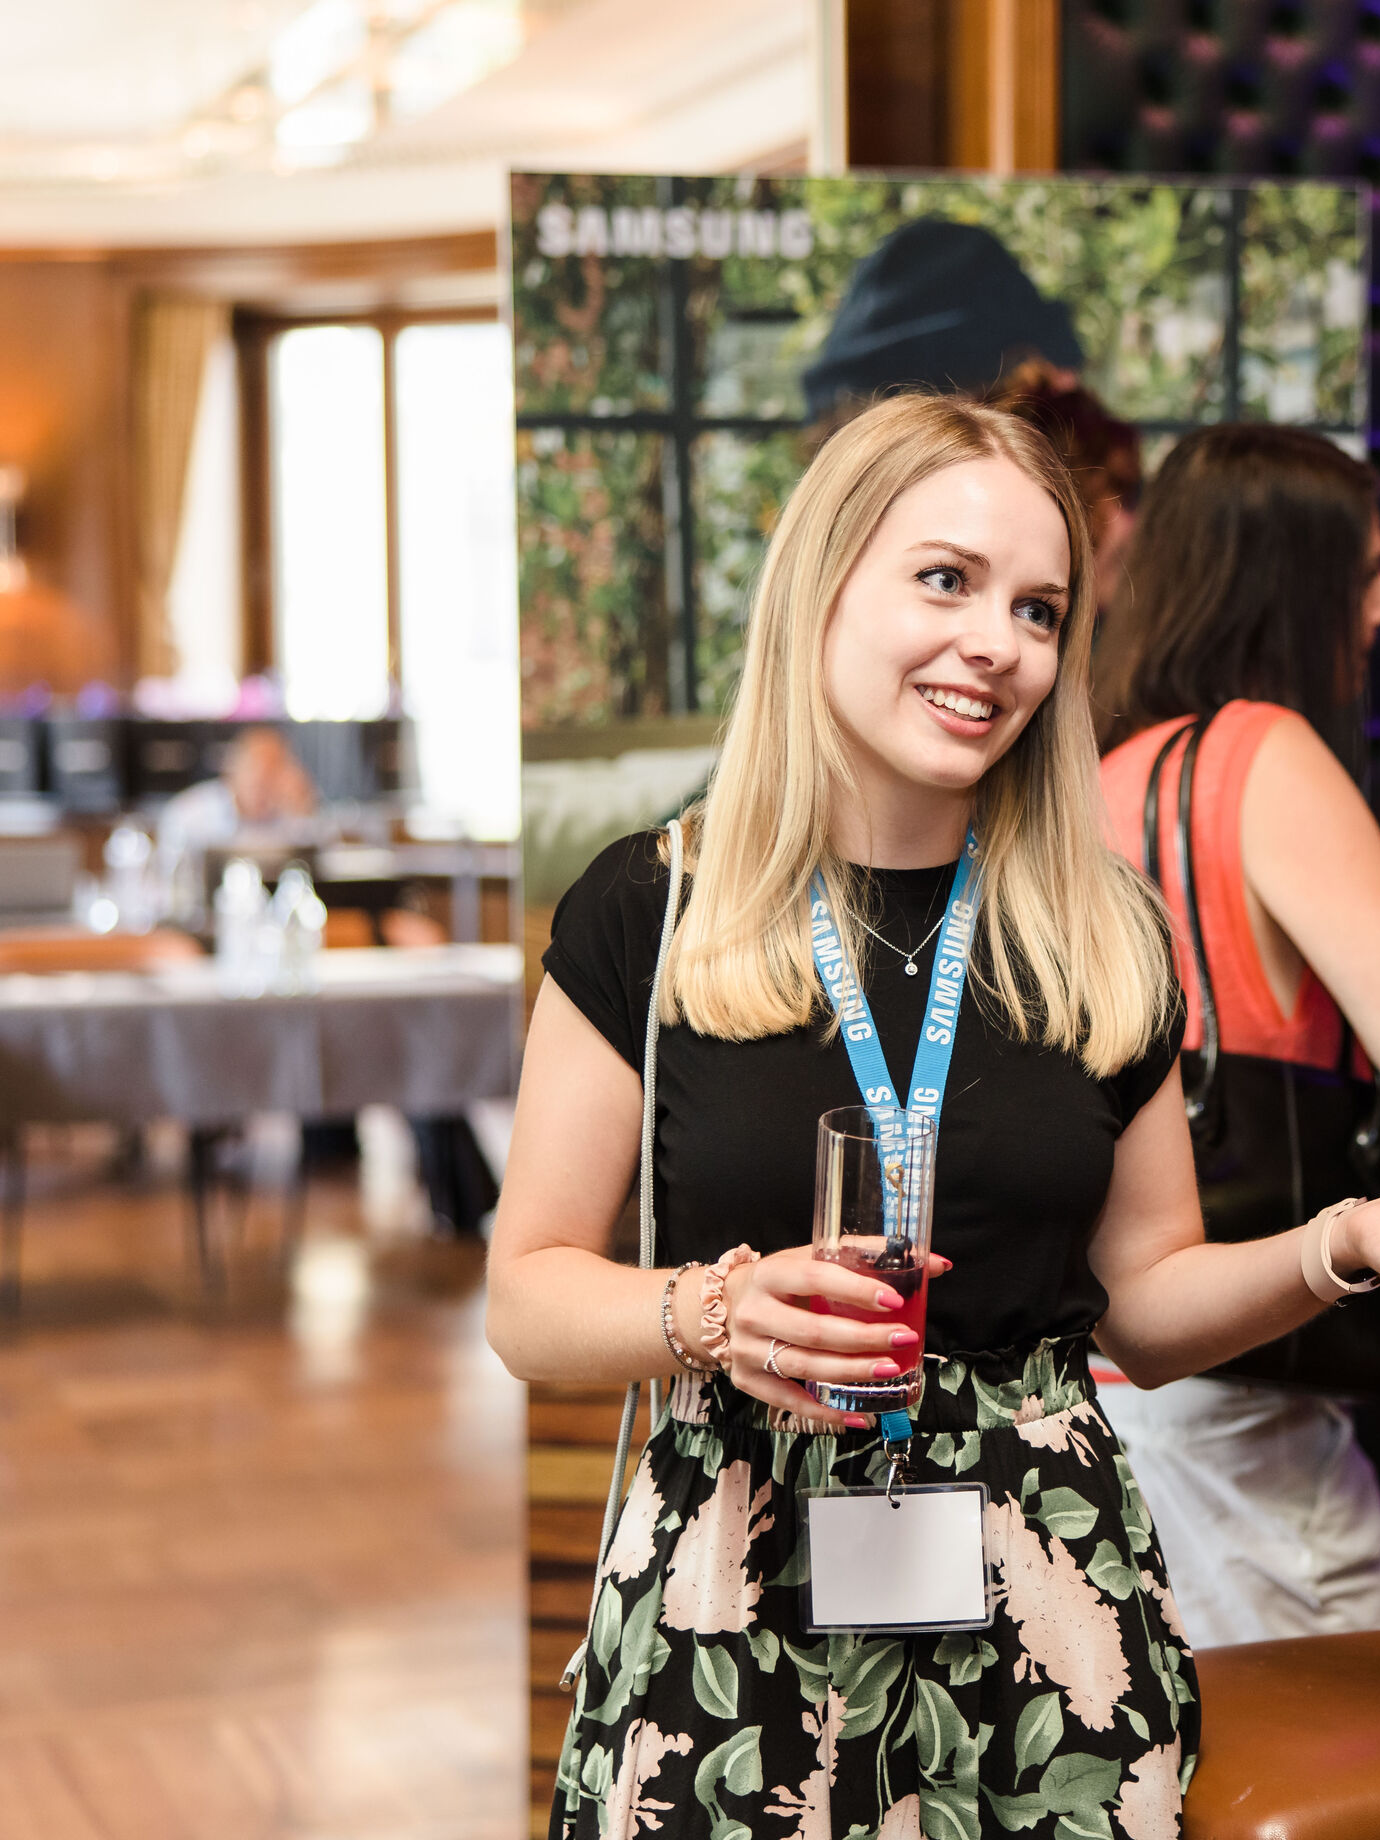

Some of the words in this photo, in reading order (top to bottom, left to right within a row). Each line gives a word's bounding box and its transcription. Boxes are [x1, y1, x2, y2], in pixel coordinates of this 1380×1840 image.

[536, 204, 813, 259] SAMSUNG
[811, 900, 873, 1042] SAMSUNG
[925, 899, 974, 1045] SAMSUNG
